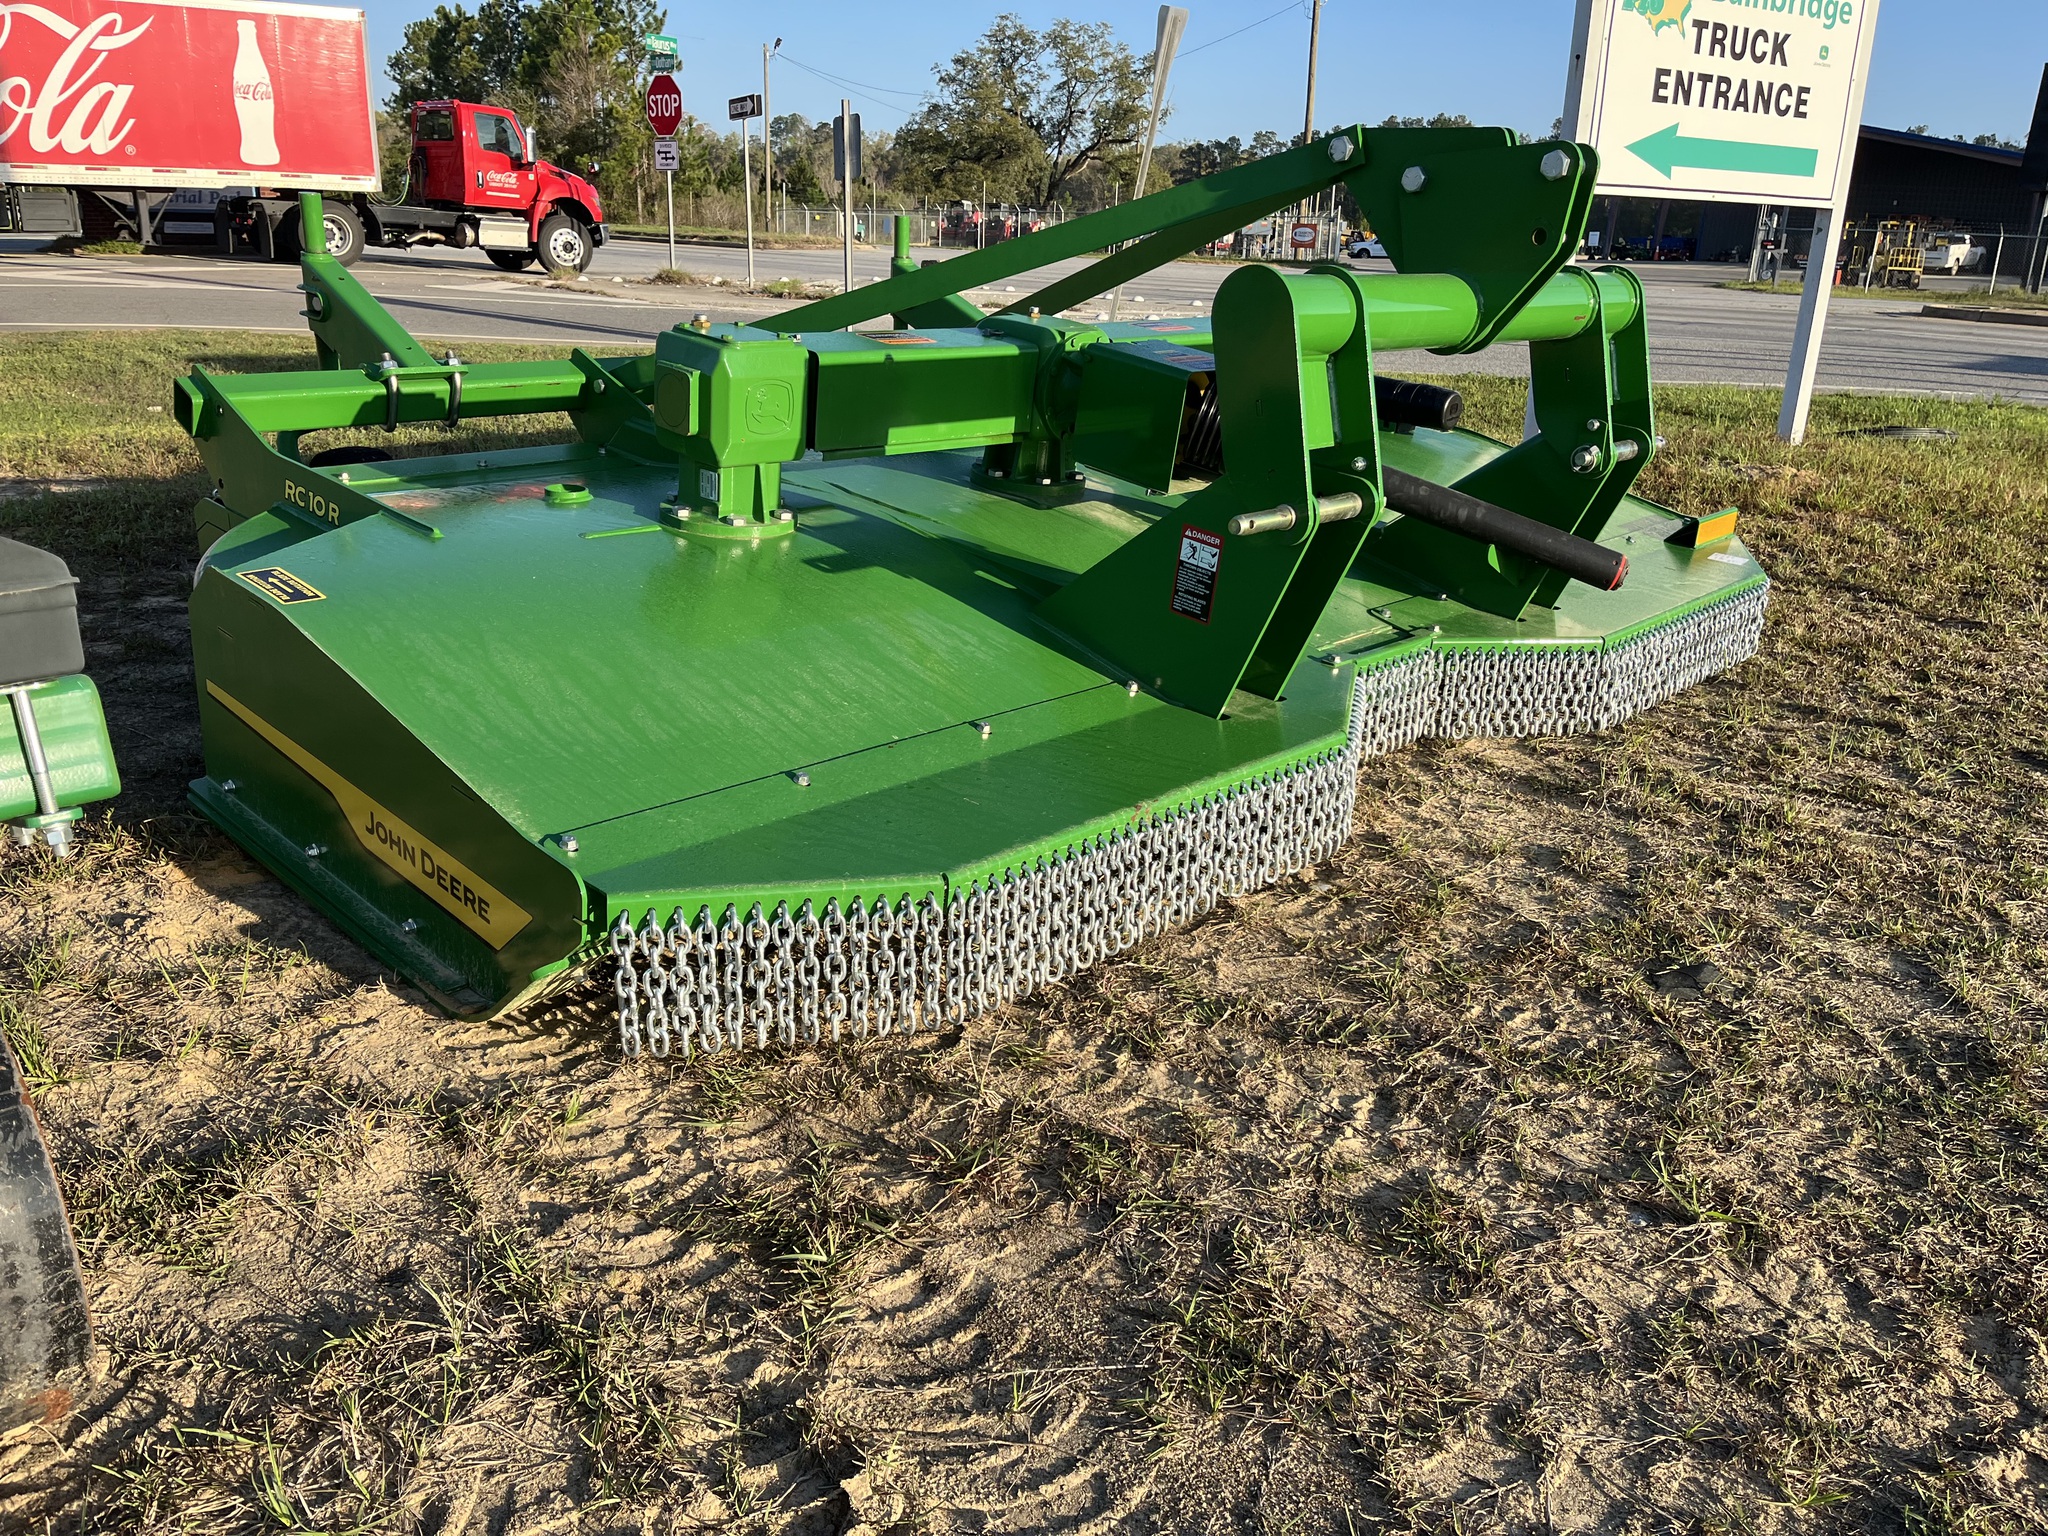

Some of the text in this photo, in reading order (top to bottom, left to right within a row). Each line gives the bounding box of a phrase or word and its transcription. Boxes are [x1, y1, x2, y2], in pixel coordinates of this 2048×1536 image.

[1691, 18, 1791, 67] TRUCK
[0, 3, 154, 155] ola
[1652, 67, 1811, 119] ENTRANCE
[649, 94, 680, 117] STOP
[285, 479, 340, 526] RC 10 R
[1192, 530, 1220, 546] DANGER
[365, 811, 491, 925] JOHN DEERE
